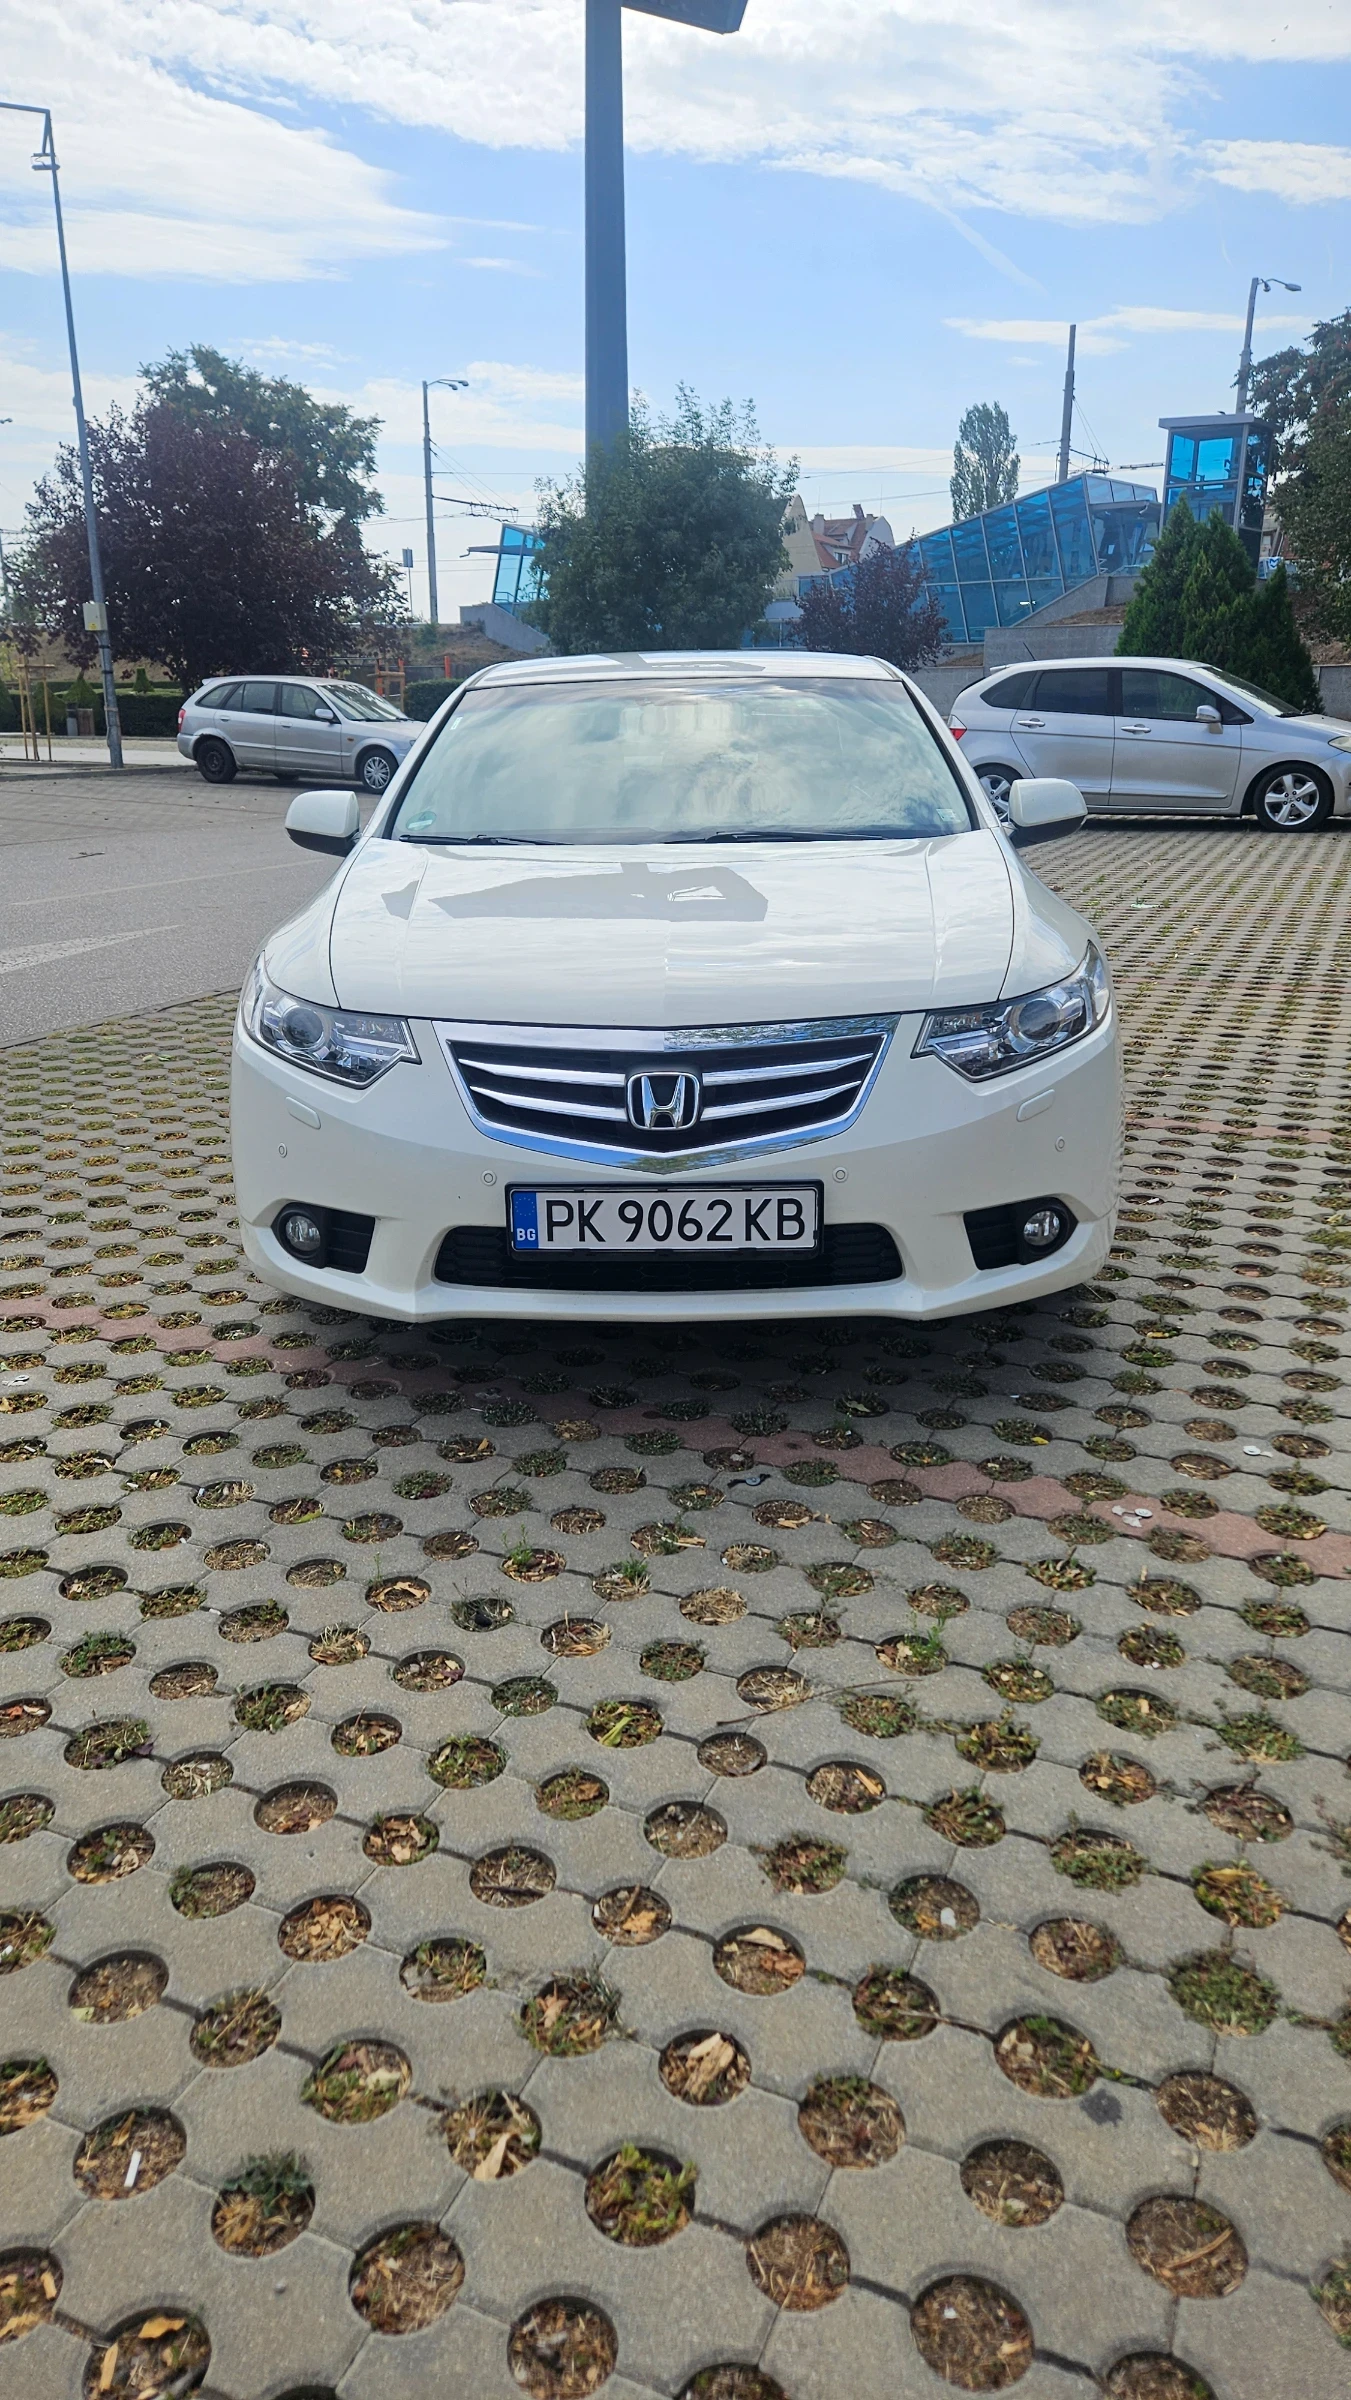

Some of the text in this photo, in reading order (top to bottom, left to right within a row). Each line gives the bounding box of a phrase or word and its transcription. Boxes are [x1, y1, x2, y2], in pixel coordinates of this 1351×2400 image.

[545, 1198, 805, 1242] PK 9062 KB
[517, 1228, 536, 1241] BG
